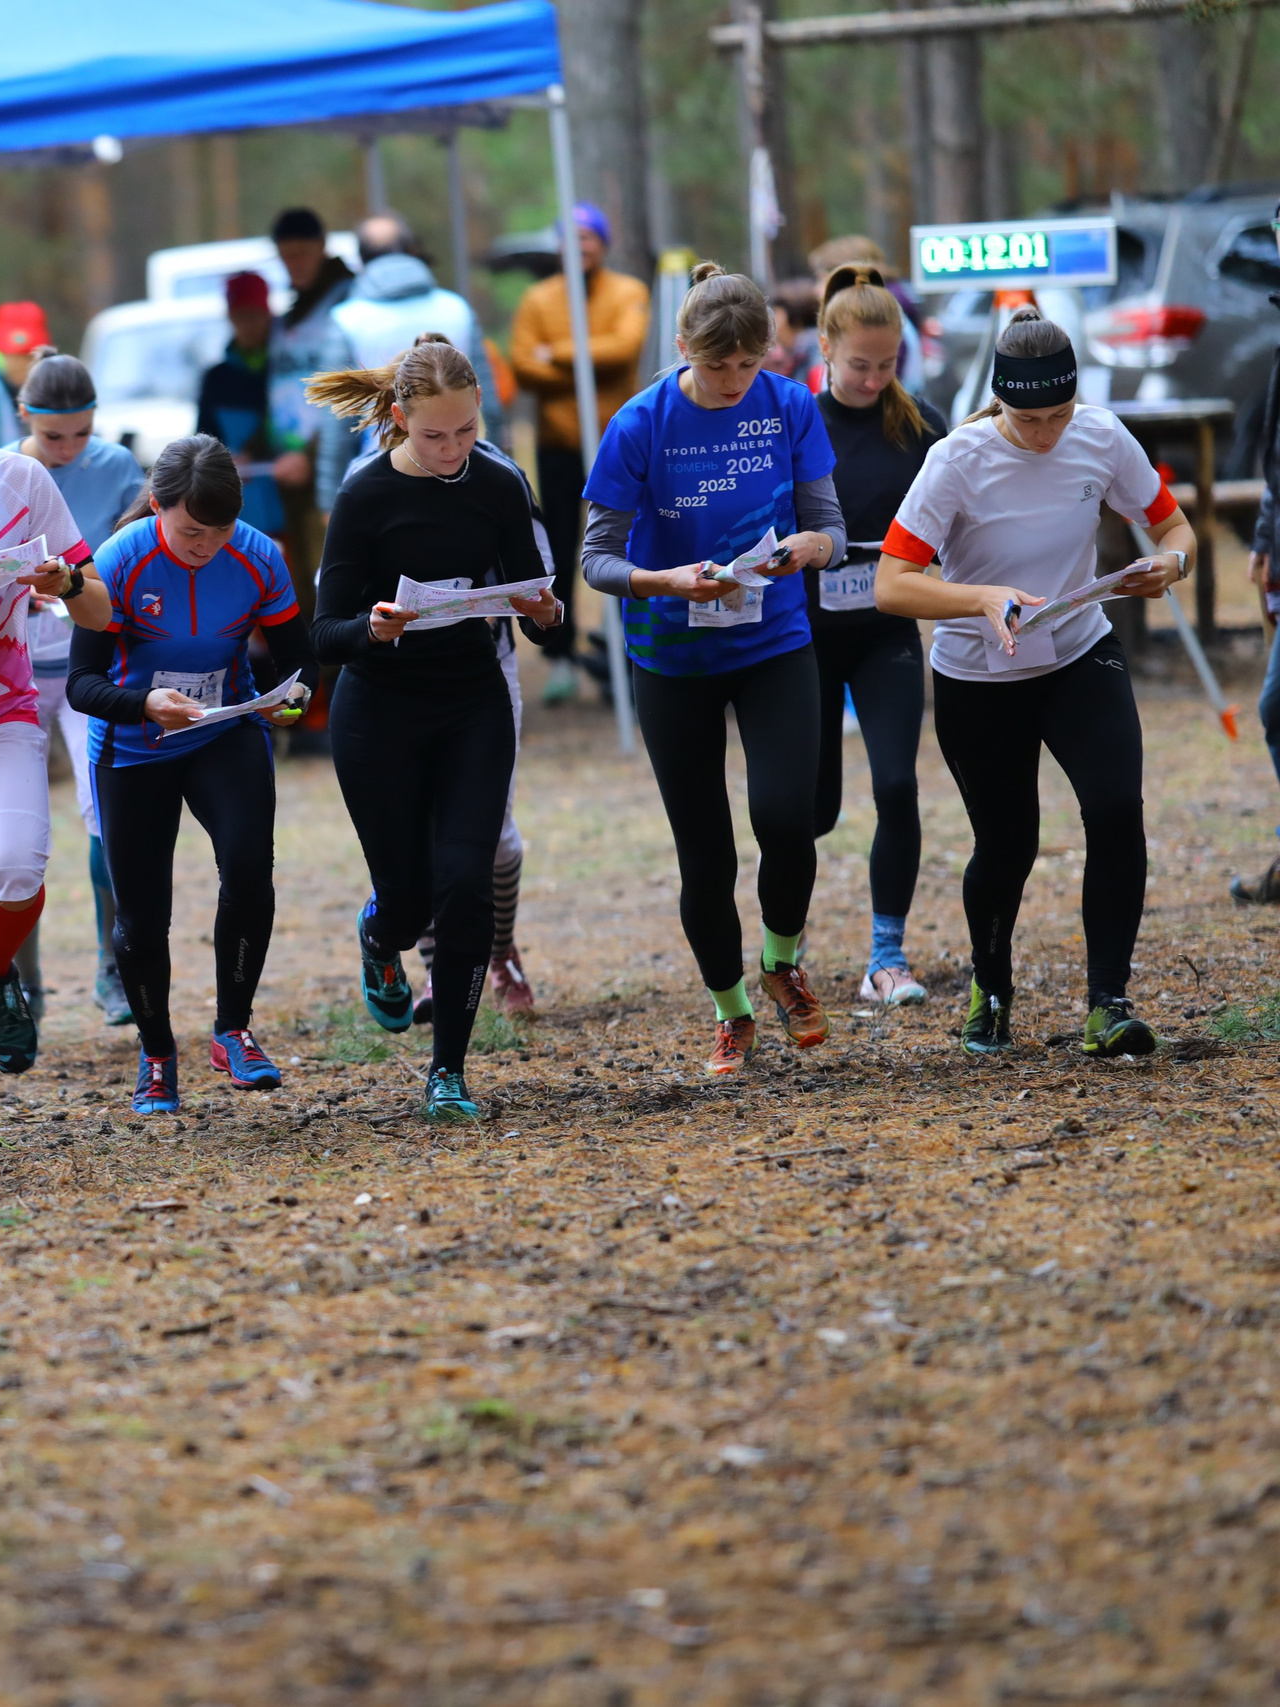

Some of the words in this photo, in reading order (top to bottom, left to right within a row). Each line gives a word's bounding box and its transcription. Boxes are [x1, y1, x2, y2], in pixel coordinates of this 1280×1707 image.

[737, 418, 782, 437] 2025
[664, 446, 707, 456] ТРОПА
[712, 439, 773, 453] ЗАЙЦЕВА
[665, 461, 719, 473] ТЮМЕНЬ
[726, 454, 773, 475] 2024
[698, 478, 737, 493] 2023
[675, 496, 708, 507] 2022
[658, 508, 680, 519] 2021
[842, 578, 868, 594] 120
